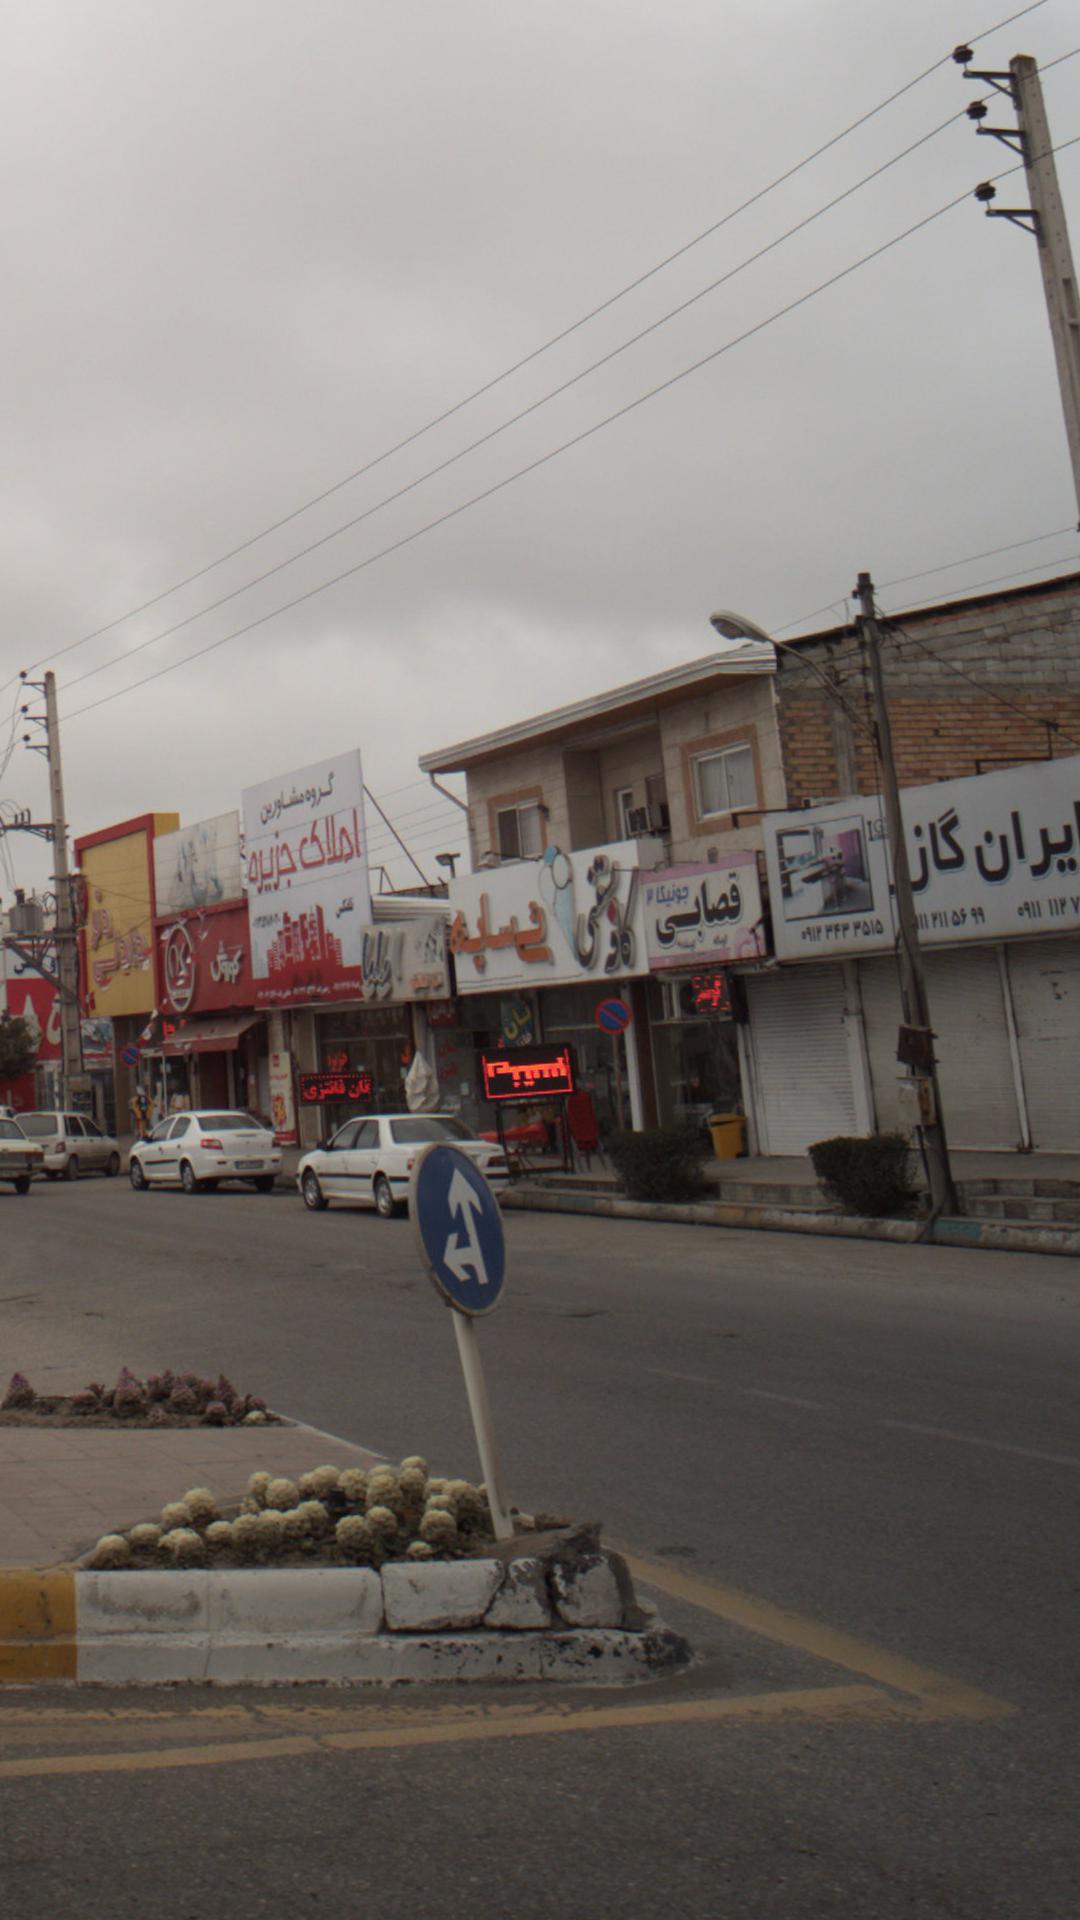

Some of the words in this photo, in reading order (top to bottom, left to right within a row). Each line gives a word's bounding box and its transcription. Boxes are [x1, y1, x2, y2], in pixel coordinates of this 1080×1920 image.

[260, 786, 305, 825] مشاورین
[305, 771, 335, 808] گروه
[299, 807, 361, 870] املاک
[248, 830, 297, 894] جزیره
[655, 872, 743, 947] قصابی
[302, 1078, 346, 1102] فانتزی
[347, 1077, 372, 1100] نان
